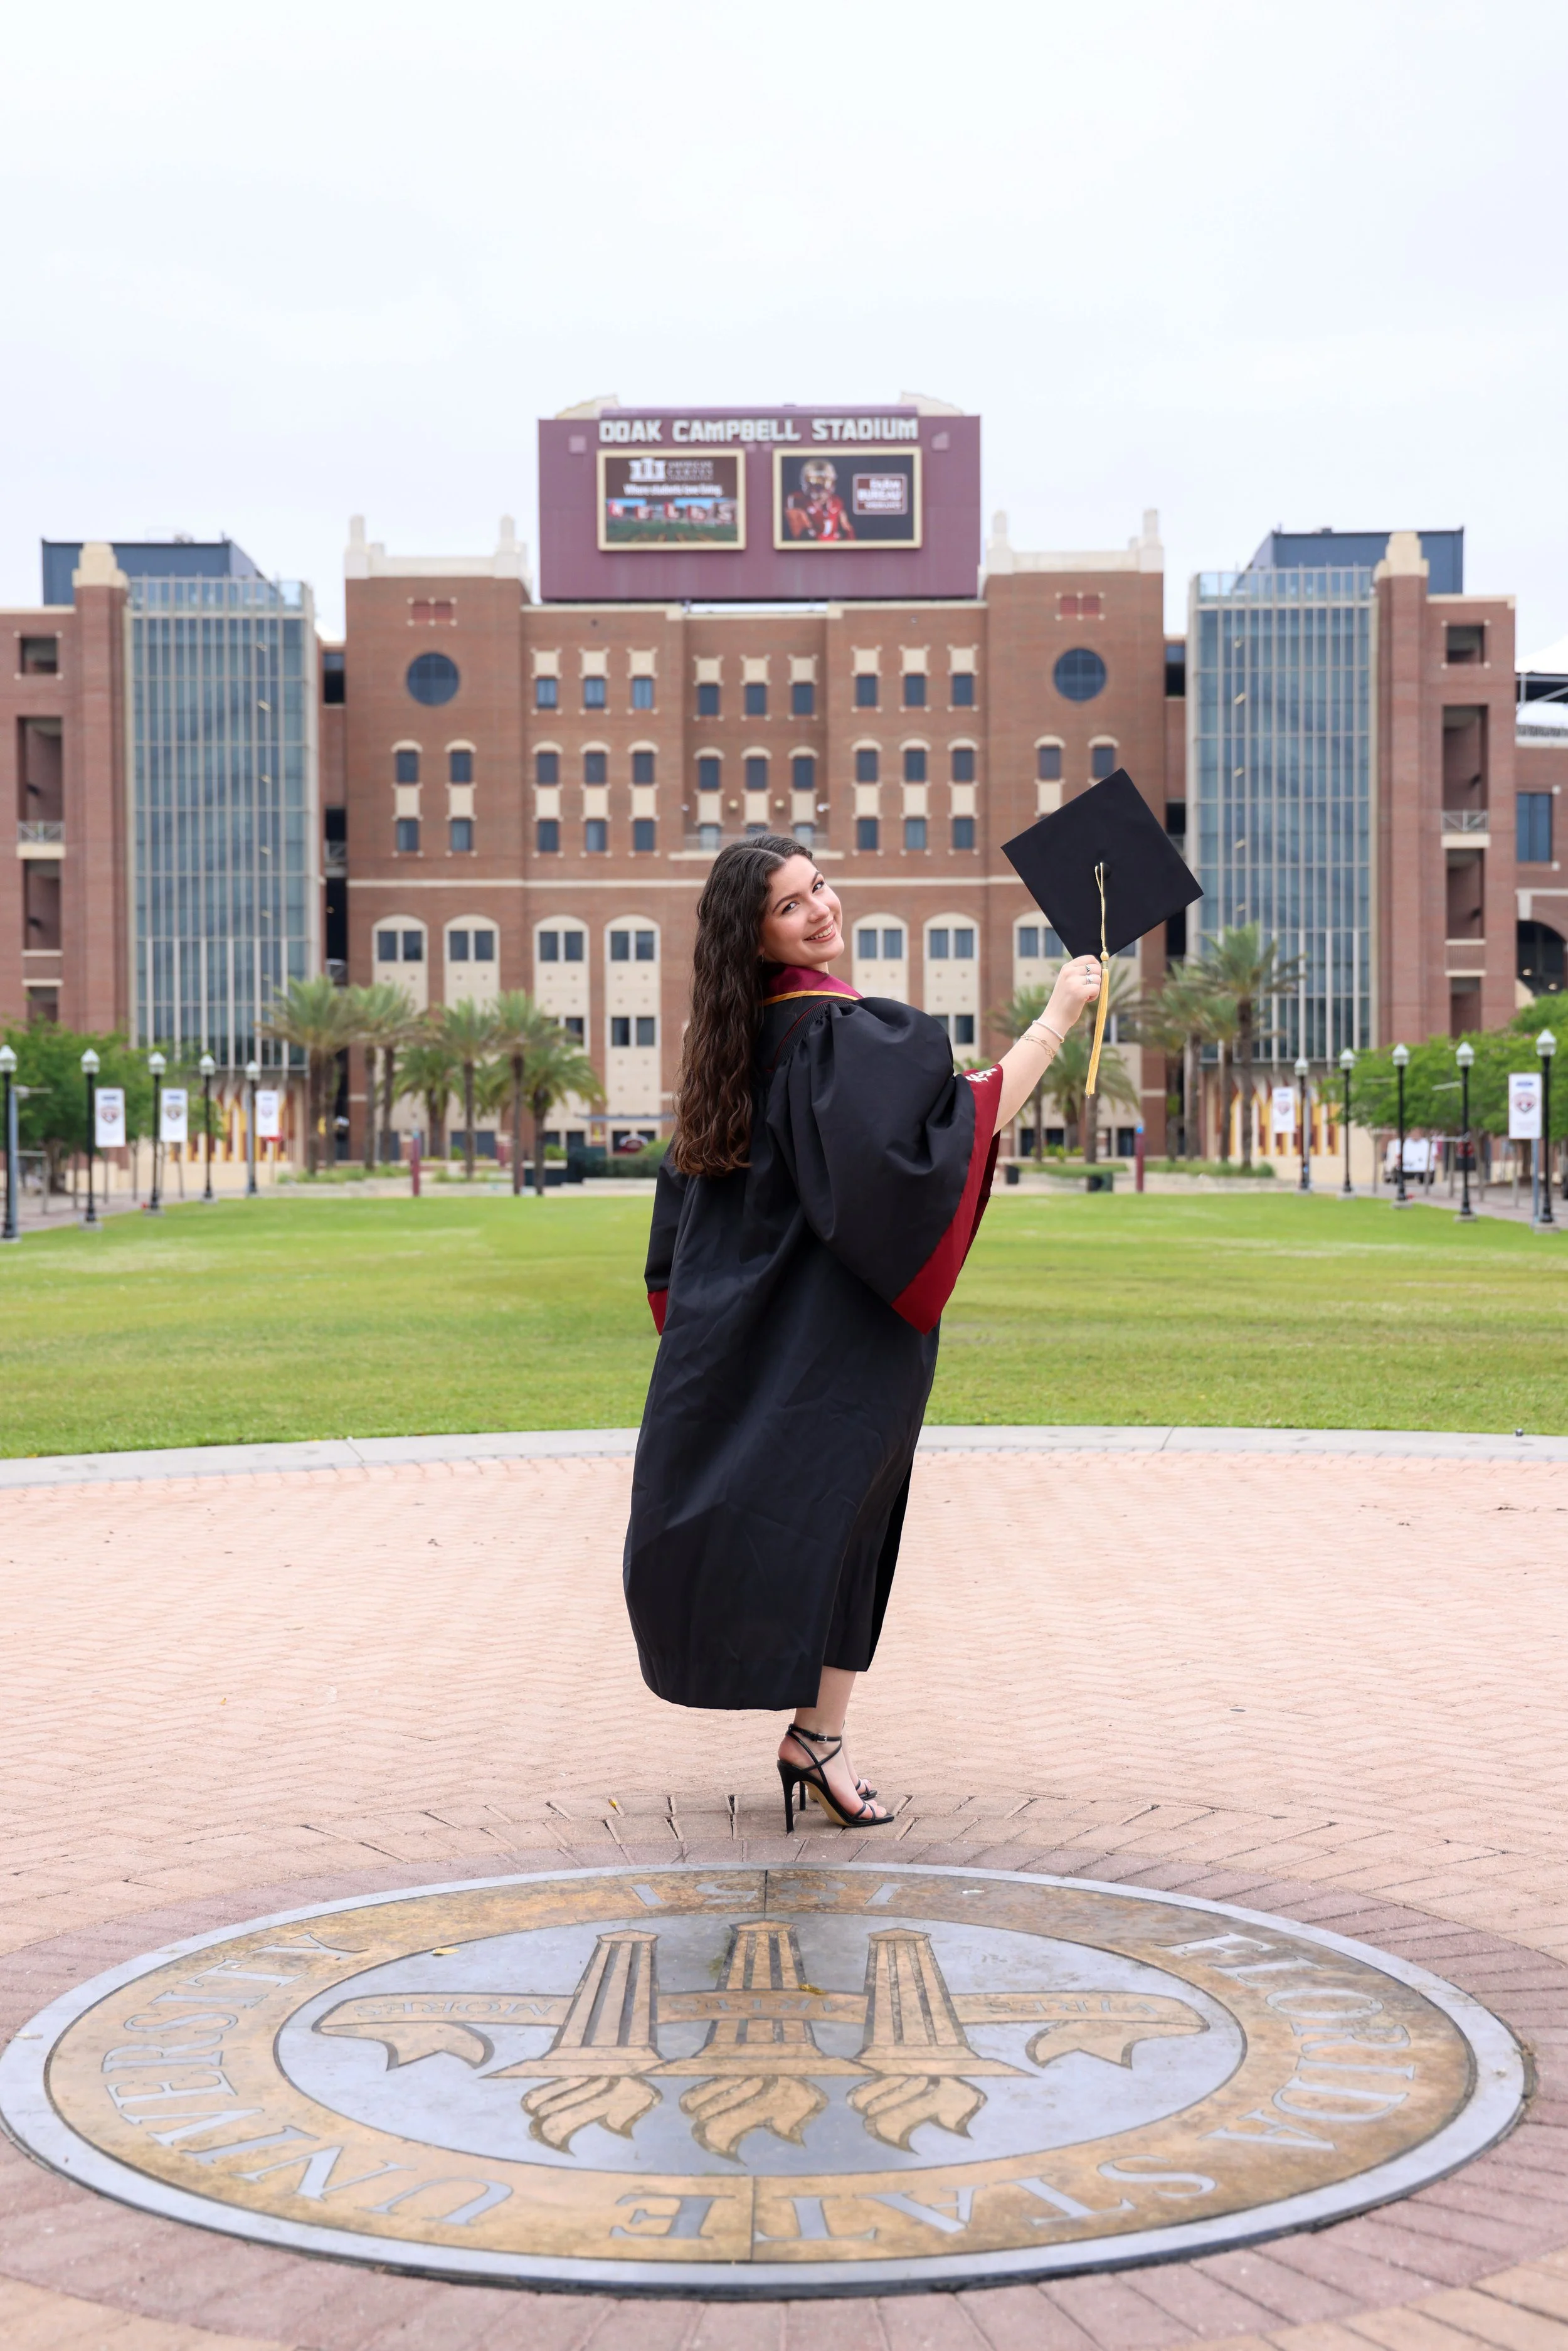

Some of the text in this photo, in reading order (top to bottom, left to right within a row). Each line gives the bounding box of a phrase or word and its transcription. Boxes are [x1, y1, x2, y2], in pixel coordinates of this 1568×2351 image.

[599, 417, 918, 443] DOAK CAMPBELL STADIUM
[354, 2000, 558, 2018] MORES
[100, 1932, 1416, 2242] FLORIDA STATE UNIVERSITY
